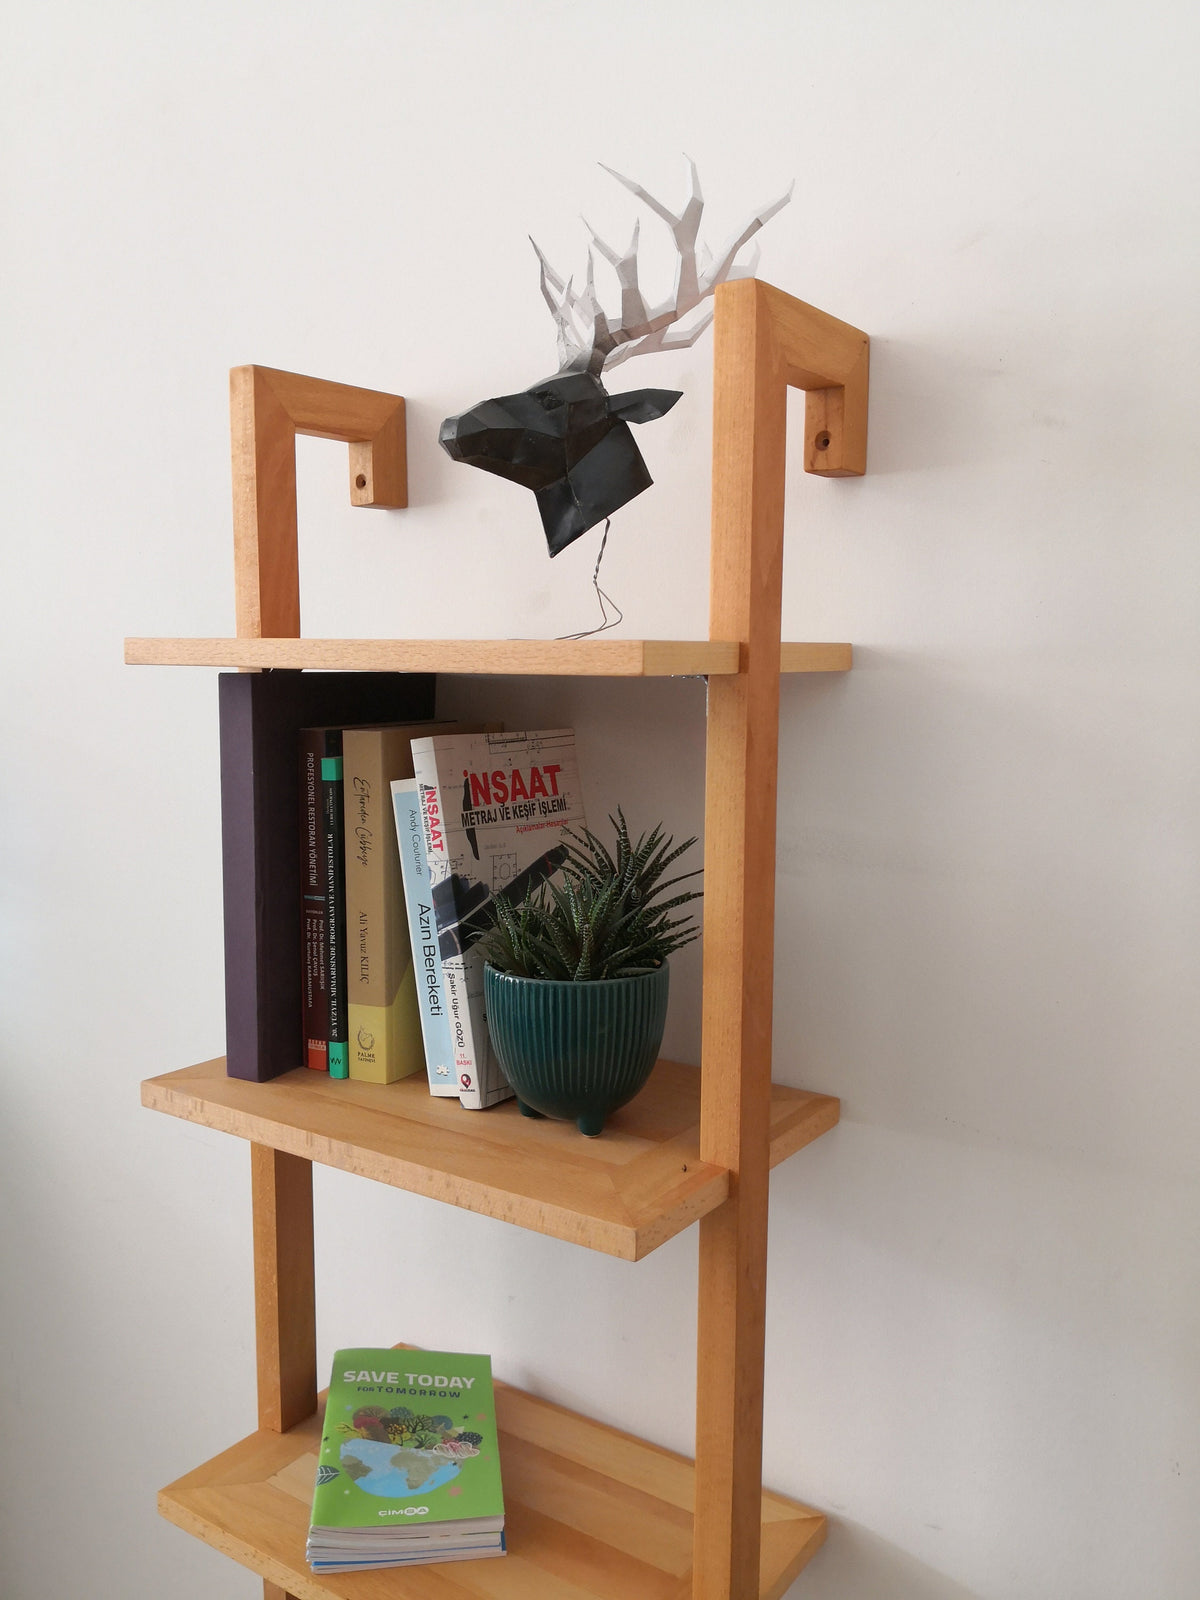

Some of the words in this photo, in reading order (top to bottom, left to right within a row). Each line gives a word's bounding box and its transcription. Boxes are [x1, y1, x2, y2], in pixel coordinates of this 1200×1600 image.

[307, 752, 316, 805] PROFESYONEL
[419, 784, 427, 806] METRAJ
[409, 809, 418, 832] Andy
[422, 807, 428, 816] VE
[461, 809, 498, 828] METRAJ
[500, 806, 511, 821] VE
[512, 803, 536, 821] KEŞİF
[538, 796, 567, 818] İŞLEMİ
[308, 807, 317, 847] RESTORAN
[309, 848, 318, 886] YÖNETİMİ
[328, 894, 335, 905] VE
[359, 912, 369, 925] Ali
[417, 902, 434, 941] Azın
[359, 928, 369, 954] Yavuz
[359, 955, 370, 984] KILIÇ
[422, 945, 443, 1016] Bereketi
[447, 973, 457, 996] Şakir
[451, 998, 460, 1019] Uğur
[455, 1021, 465, 1048] GÖZÜ
[357, 1051, 375, 1059] PALME
[343, 1370, 400, 1384] SAVE
[404, 1373, 476, 1389] TODAY
[377, 1386, 461, 1398] TOMORROW
